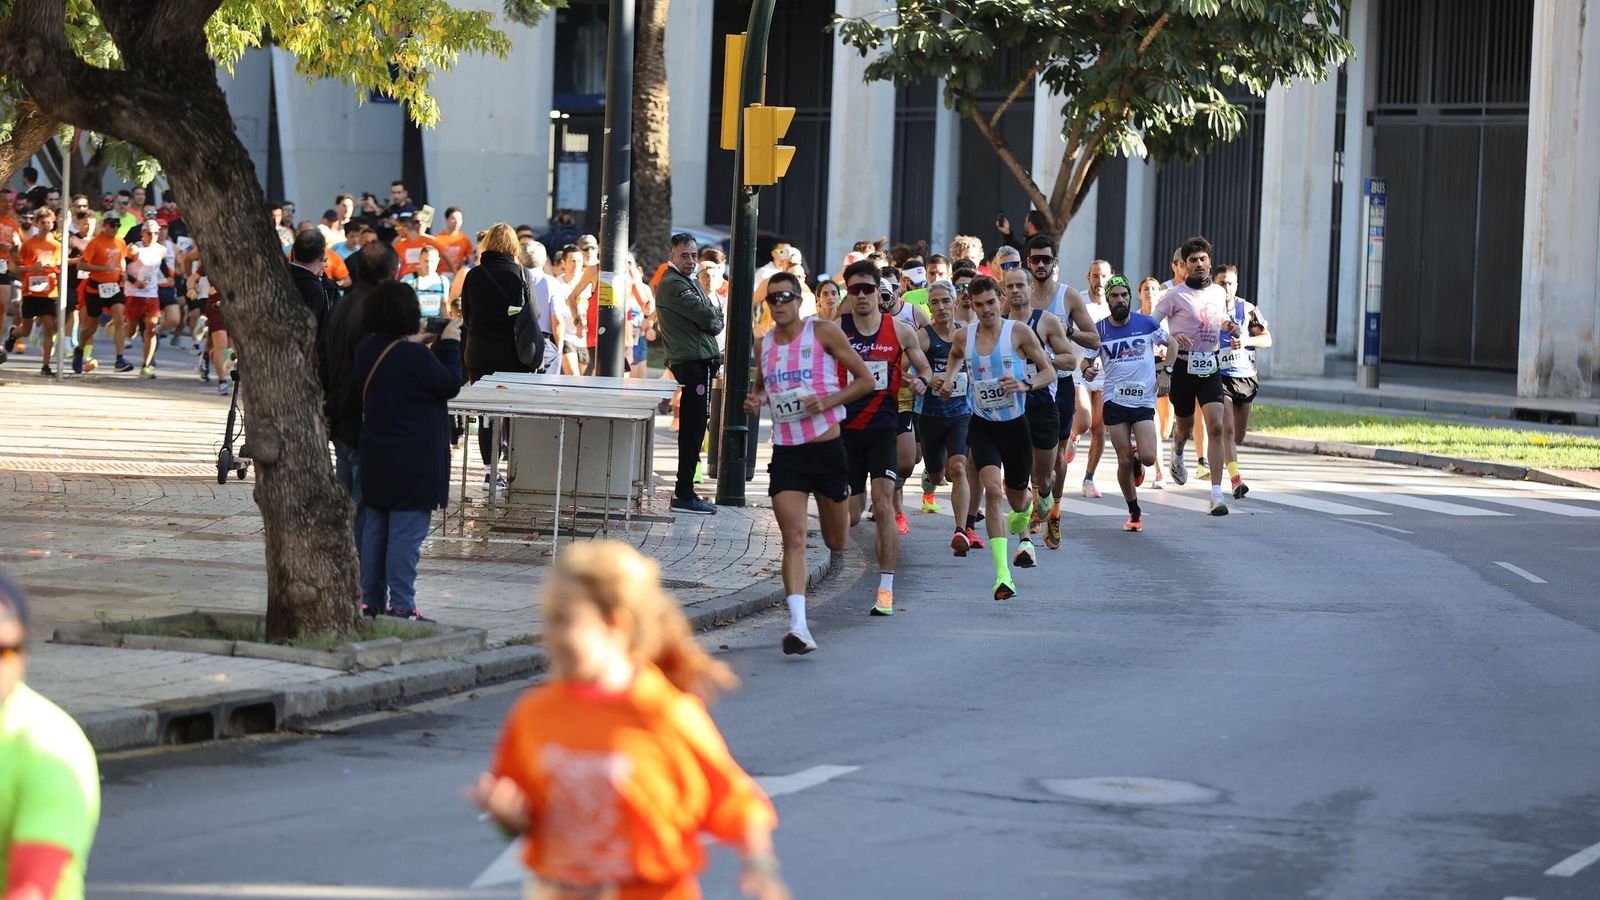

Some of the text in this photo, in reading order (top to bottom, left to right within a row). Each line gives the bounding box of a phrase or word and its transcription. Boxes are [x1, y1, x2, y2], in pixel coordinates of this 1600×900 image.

[1371, 180, 1386, 193] BUS
[1103, 338, 1145, 359] VAS
[1192, 360, 1213, 368] 324
[980, 388, 1005, 400] 330
[1118, 388, 1144, 397] 1029
[776, 400, 801, 414] 117
